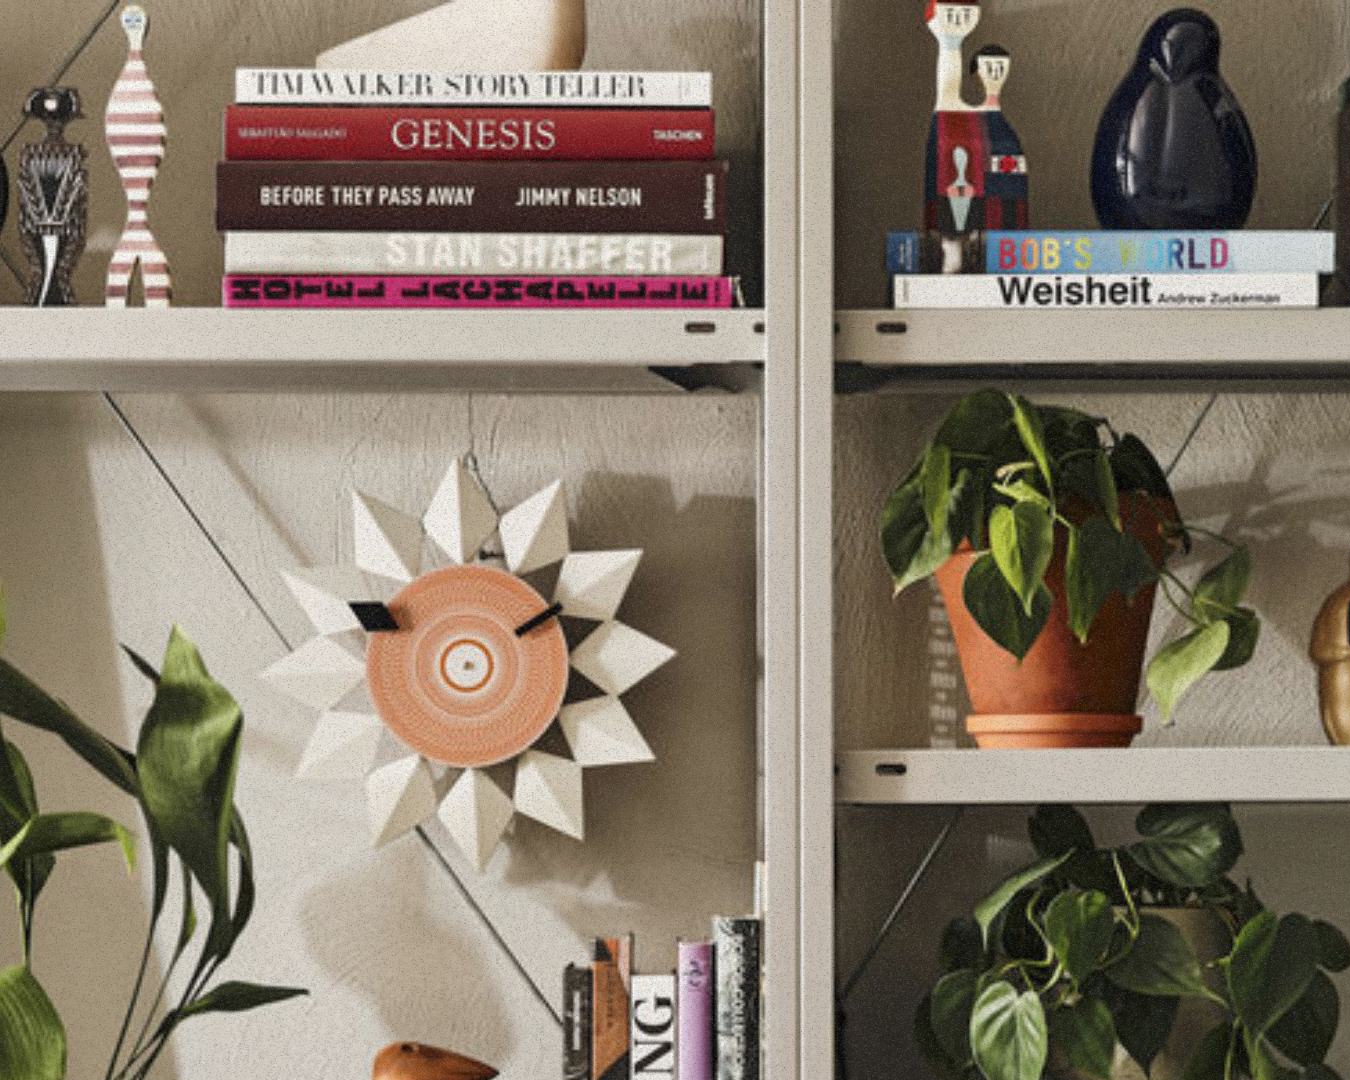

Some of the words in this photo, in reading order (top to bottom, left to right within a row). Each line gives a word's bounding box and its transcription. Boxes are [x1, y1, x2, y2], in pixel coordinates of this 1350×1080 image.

[252, 71, 309, 98] TIM
[312, 71, 433, 98] WALKER
[443, 73, 529, 98] STORY
[538, 74, 646, 98] TELLER
[391, 118, 557, 151] GENESIS
[653, 129, 703, 142] TASCHEN
[260, 186, 327, 207] BEFORE
[331, 186, 373, 207] THEY
[379, 186, 423, 207] PASS
[426, 186, 475, 207] AWAY
[515, 187, 570, 207] JIMMY
[576, 187, 642, 207] NELSON
[386, 235, 481, 269] STAN
[499, 237, 673, 273] SHAFFER
[1000, 237, 1093, 271] BOB'S
[1118, 238, 1230, 269] WORLD
[231, 279, 386, 300] HOTEL
[402, 280, 712, 301] LACHAPELLE
[1000, 275, 1153, 307] Weisheit
[1157, 292, 1206, 305] Andrew
[1210, 293, 1281, 305] Zuckerman
